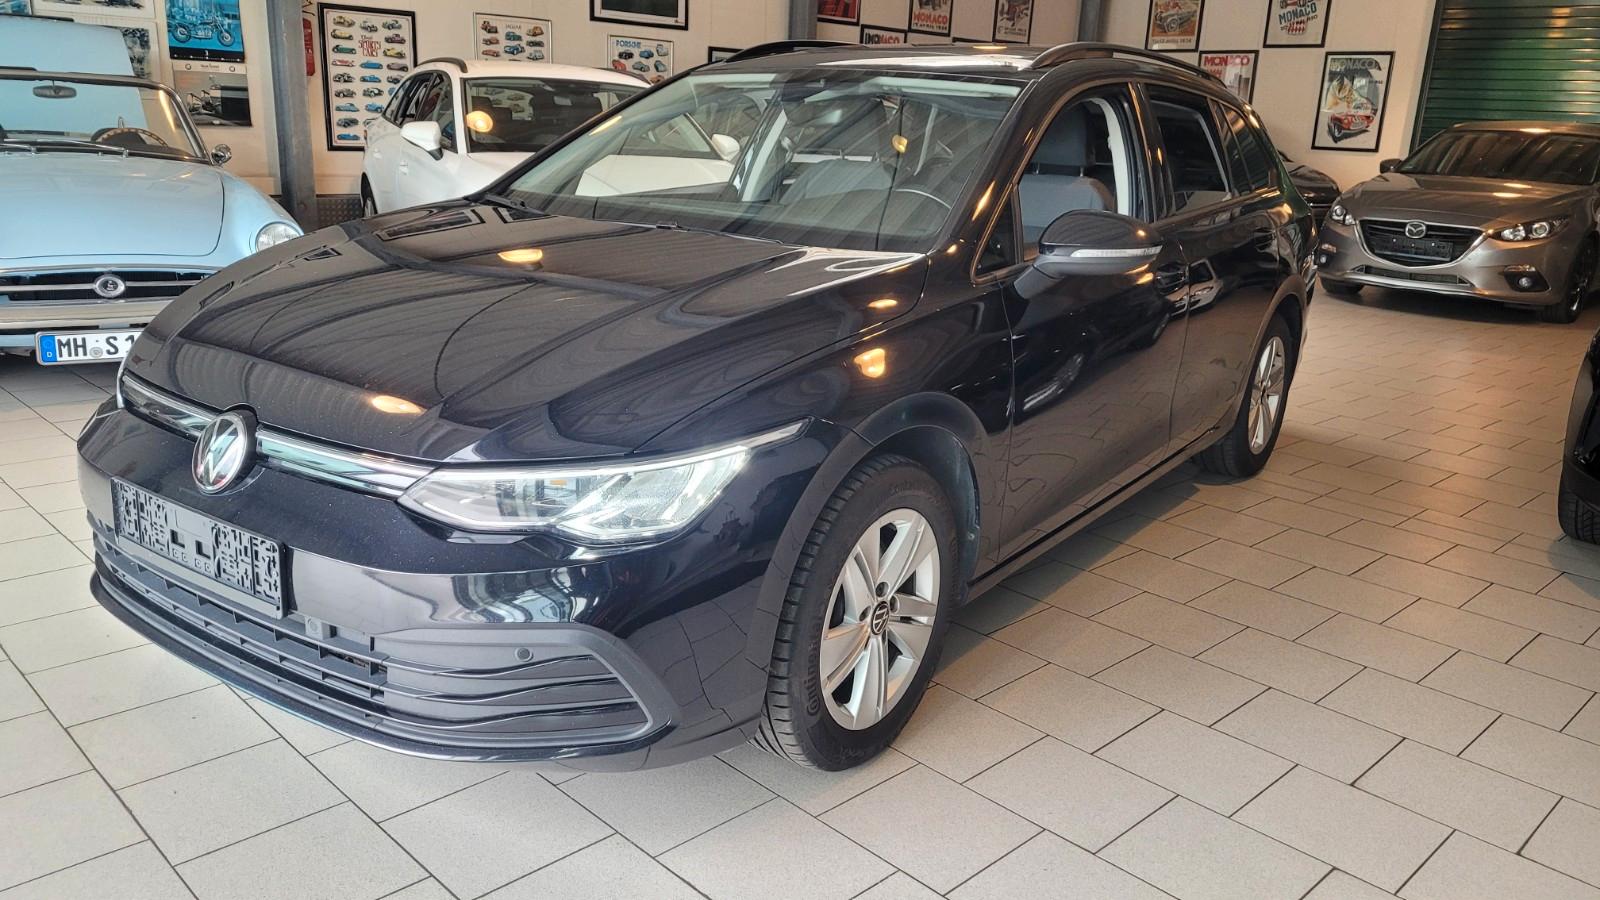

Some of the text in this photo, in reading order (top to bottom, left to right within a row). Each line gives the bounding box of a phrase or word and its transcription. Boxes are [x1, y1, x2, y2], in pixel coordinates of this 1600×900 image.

[913, 11, 948, 25] MONACO
[1279, 2, 1317, 25] MONACO
[616, 40, 641, 48] PORSCHE
[1204, 54, 1250, 66] MONACO
[57, 337, 87, 358] MH
[105, 336, 119, 355] S
